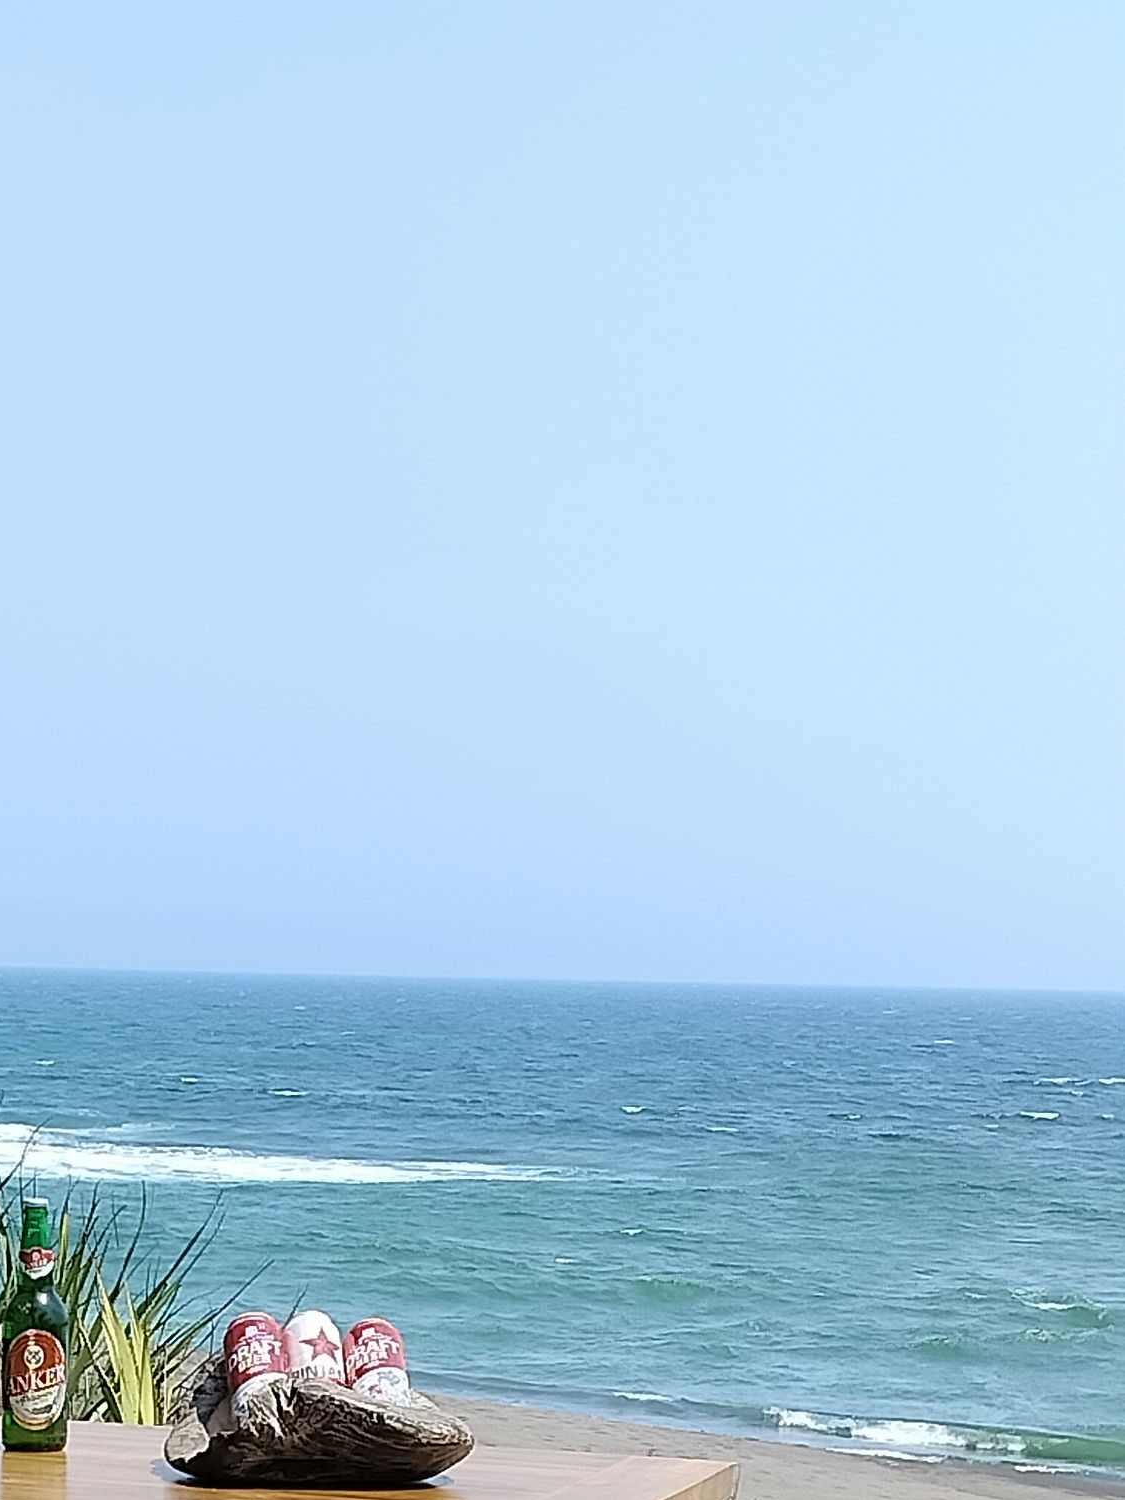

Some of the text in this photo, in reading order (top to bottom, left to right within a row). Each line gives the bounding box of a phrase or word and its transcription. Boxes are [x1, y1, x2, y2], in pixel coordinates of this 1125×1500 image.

[229, 1337, 282, 1372] DRAFT
[346, 1339, 400, 1374] DRAFT
[6, 1364, 66, 1394] ANKER
